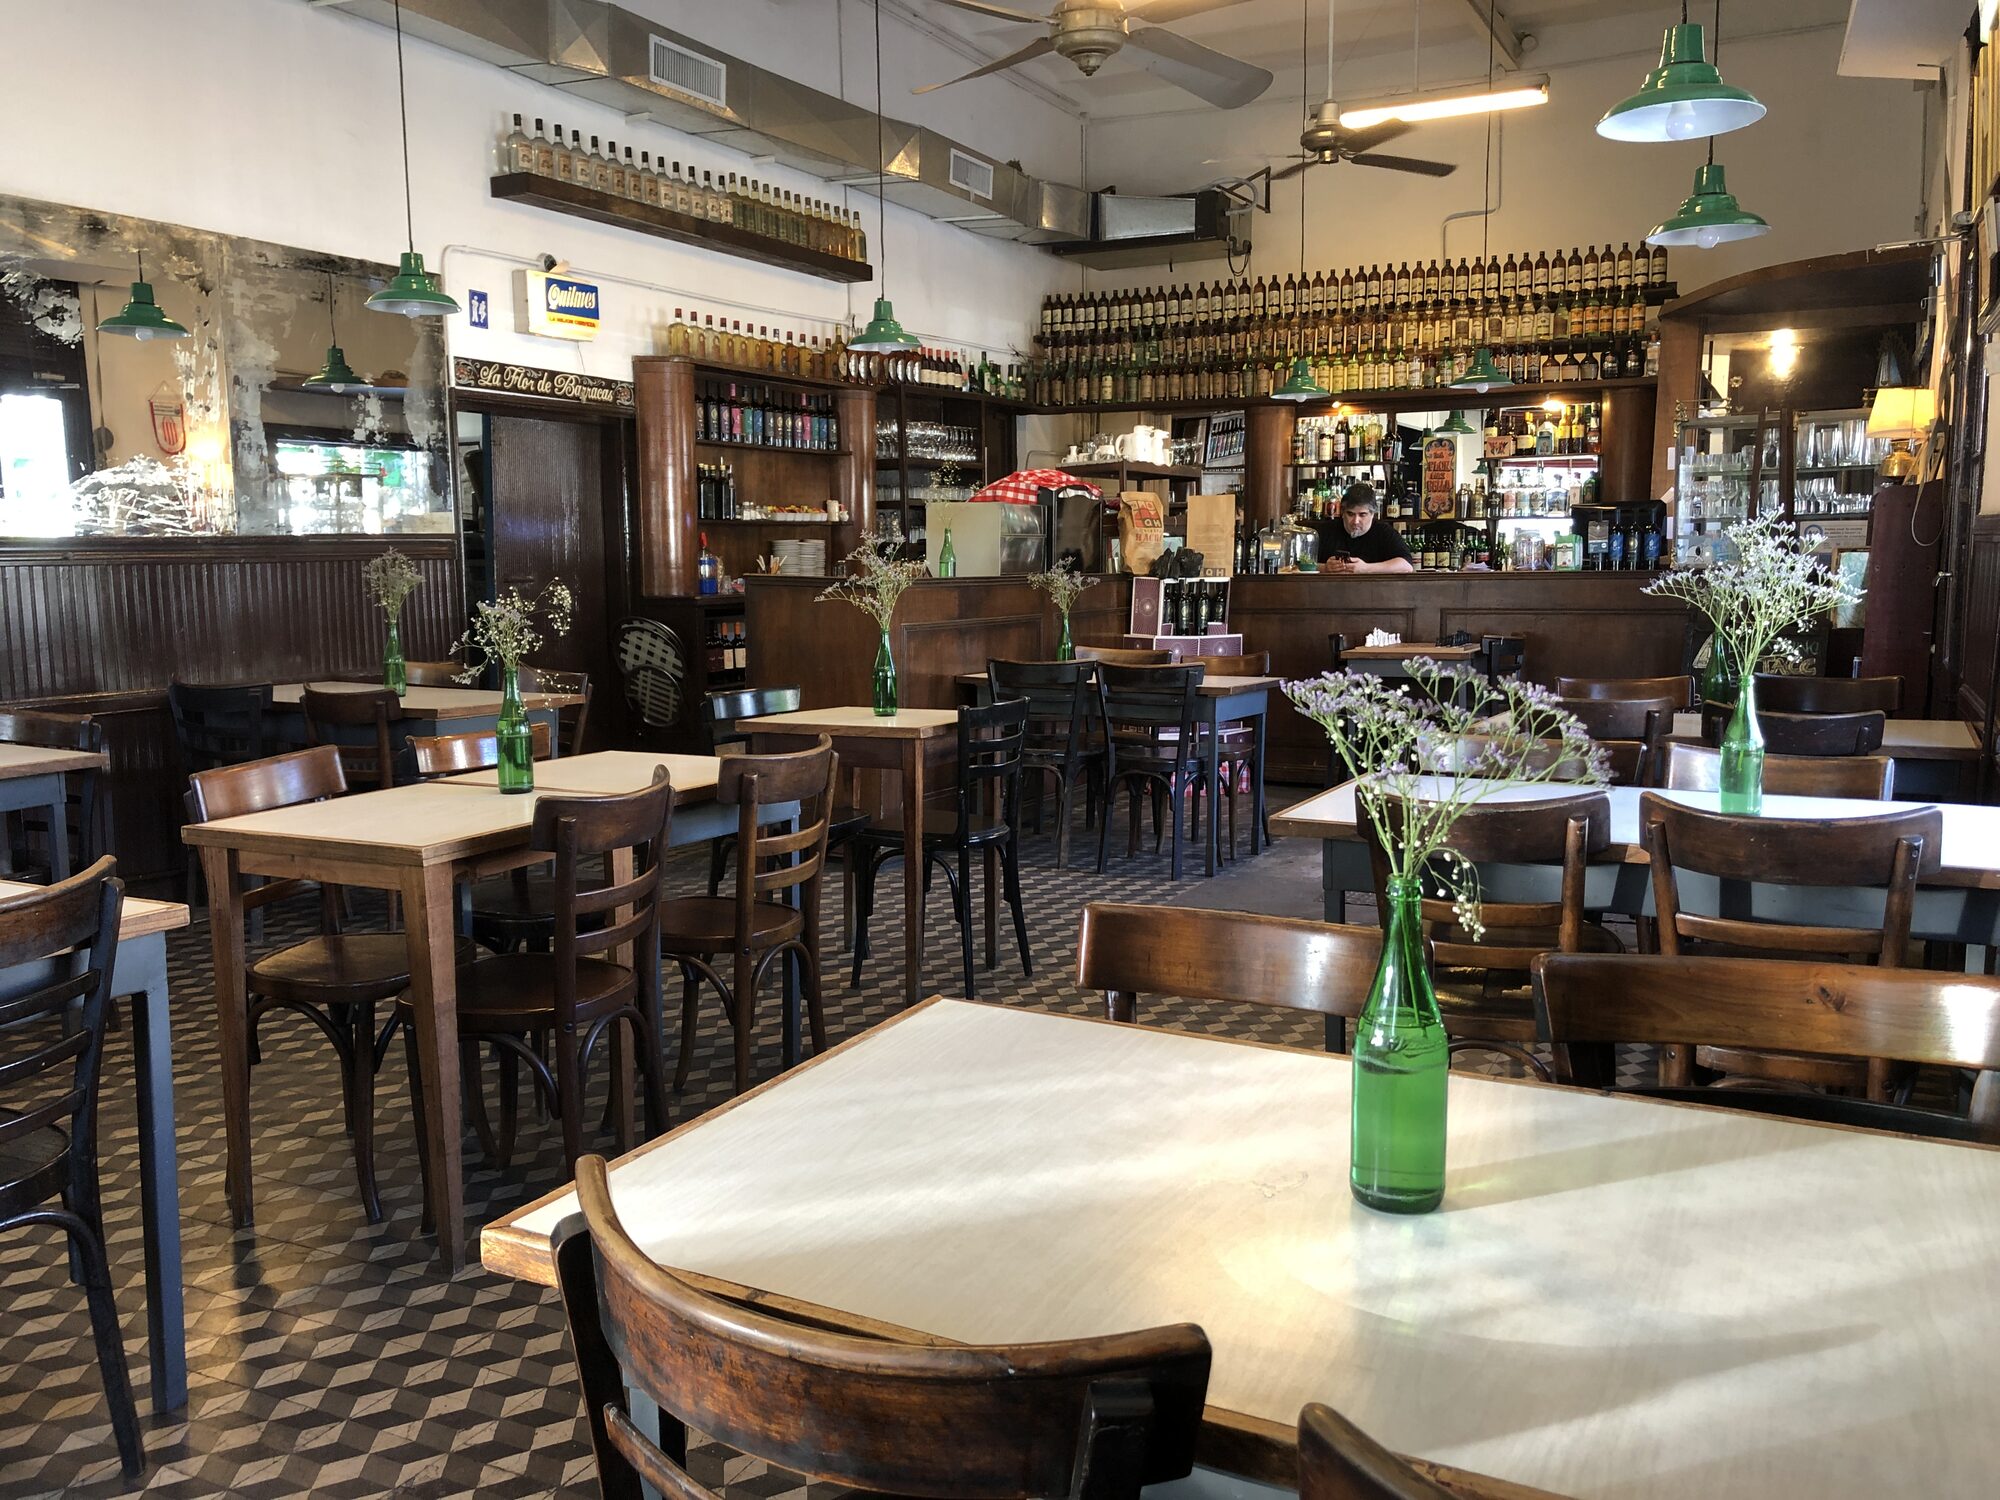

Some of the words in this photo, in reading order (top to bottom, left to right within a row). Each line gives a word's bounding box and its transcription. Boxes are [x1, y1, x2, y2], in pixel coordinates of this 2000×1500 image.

[548, 283, 596, 309] Quilmes
[478, 363, 502, 387] La
[503, 366, 535, 392] Flor
[537, 371, 552, 393] de
[554, 374, 615, 402] Barracas
